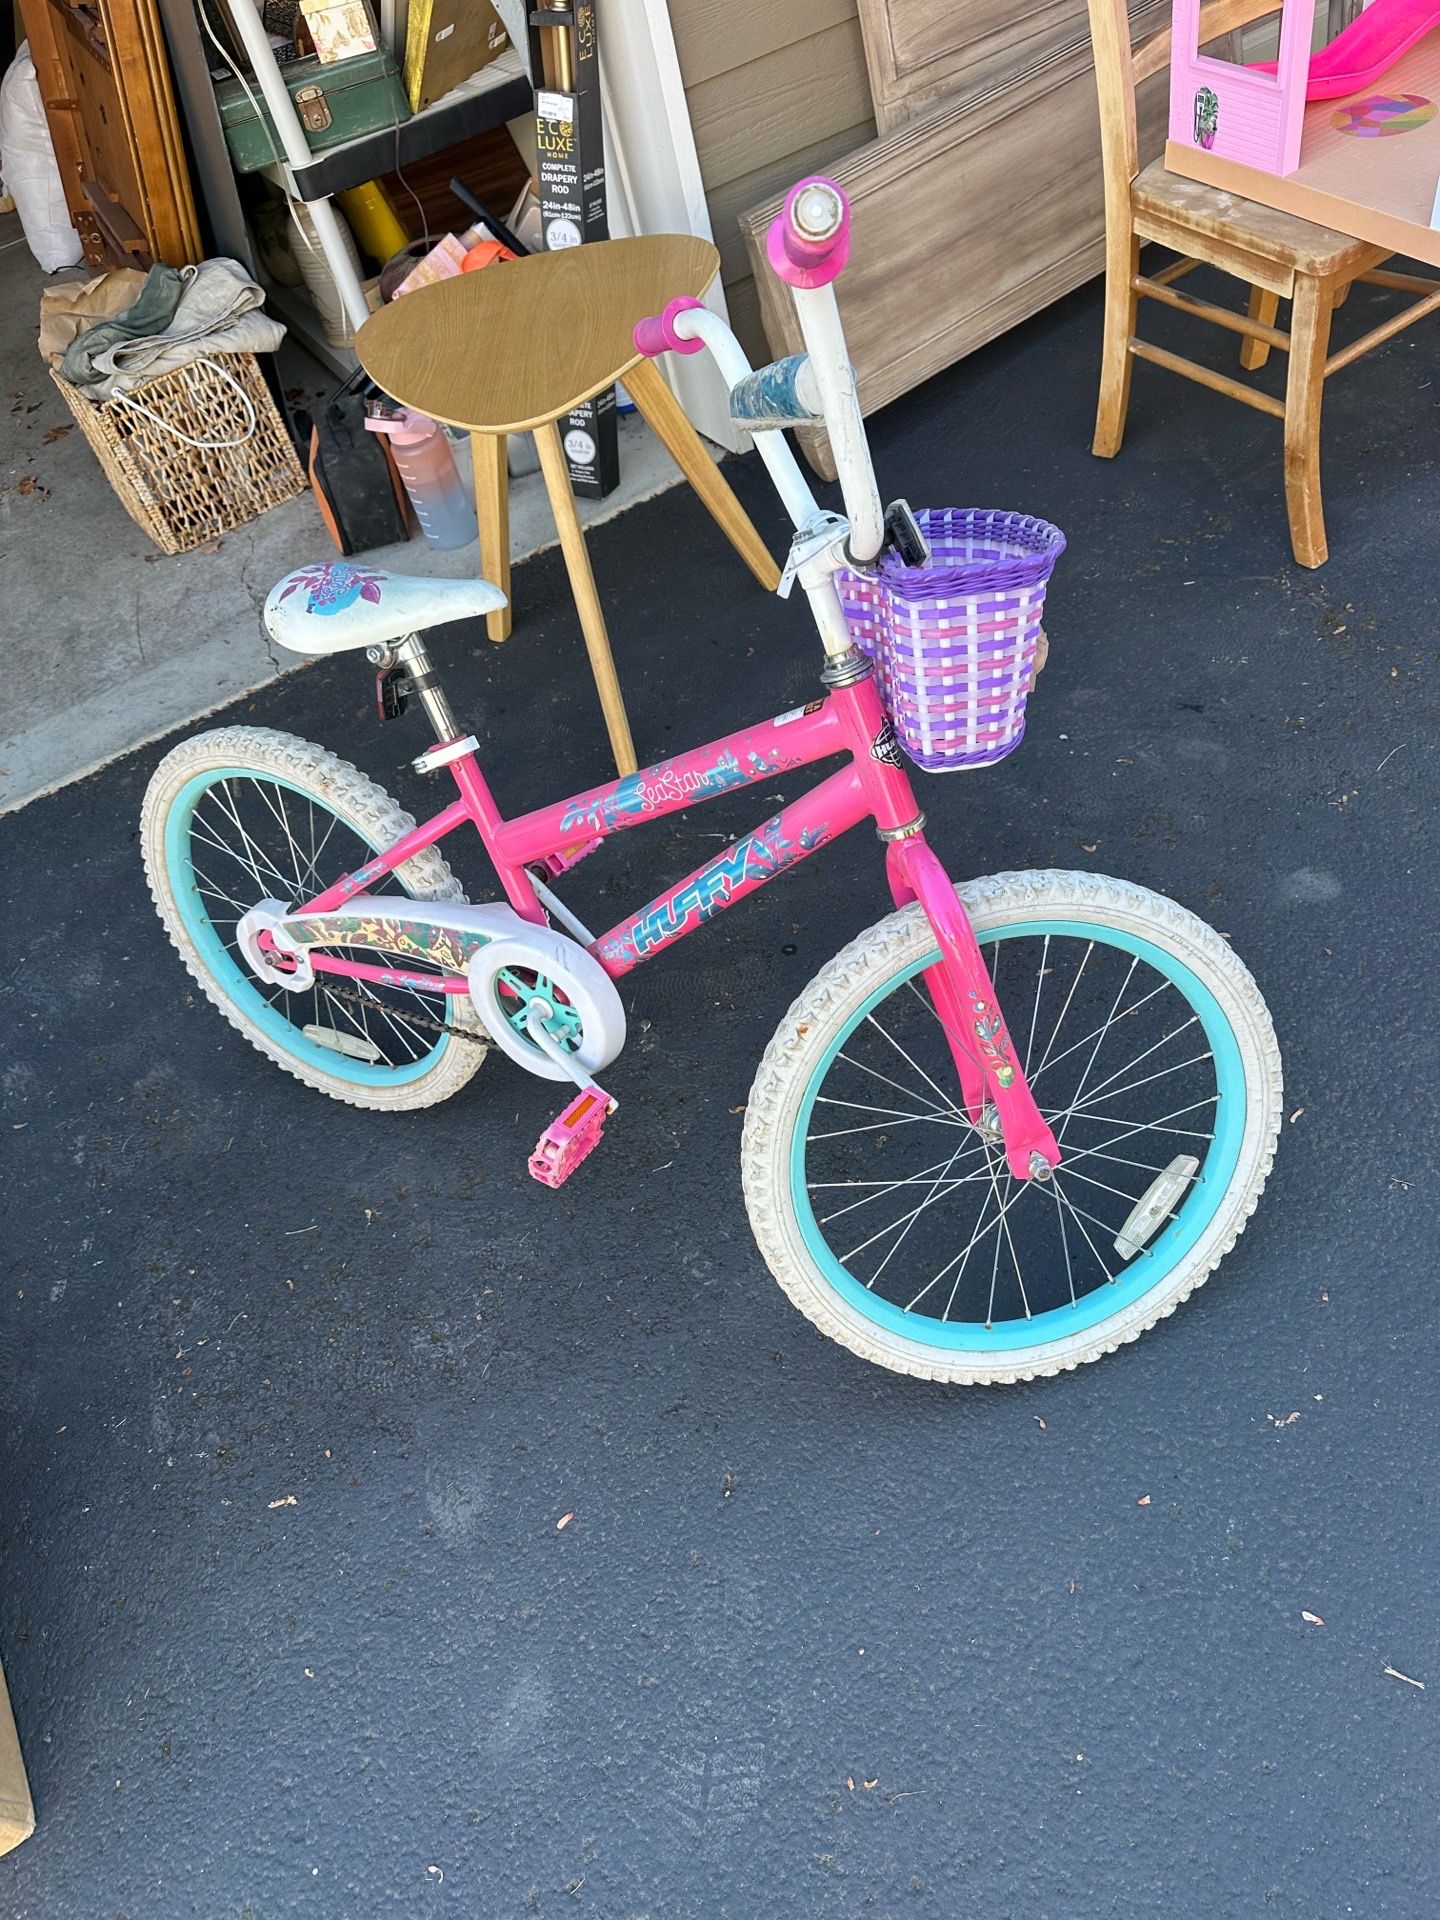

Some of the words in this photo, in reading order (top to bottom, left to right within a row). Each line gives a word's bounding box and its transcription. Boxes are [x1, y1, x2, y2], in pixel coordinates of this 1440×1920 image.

[537, 135, 574, 152] LUXE
[542, 162, 577, 173] COMPLETE
[541, 172, 578, 184] DRAPERY
[551, 184, 570, 194] ROD
[550, 231, 567, 243] 3/4
[569, 418, 586, 427] ROD
[633, 770, 709, 812] SeaStar
[632, 838, 753, 955] HUFFY
